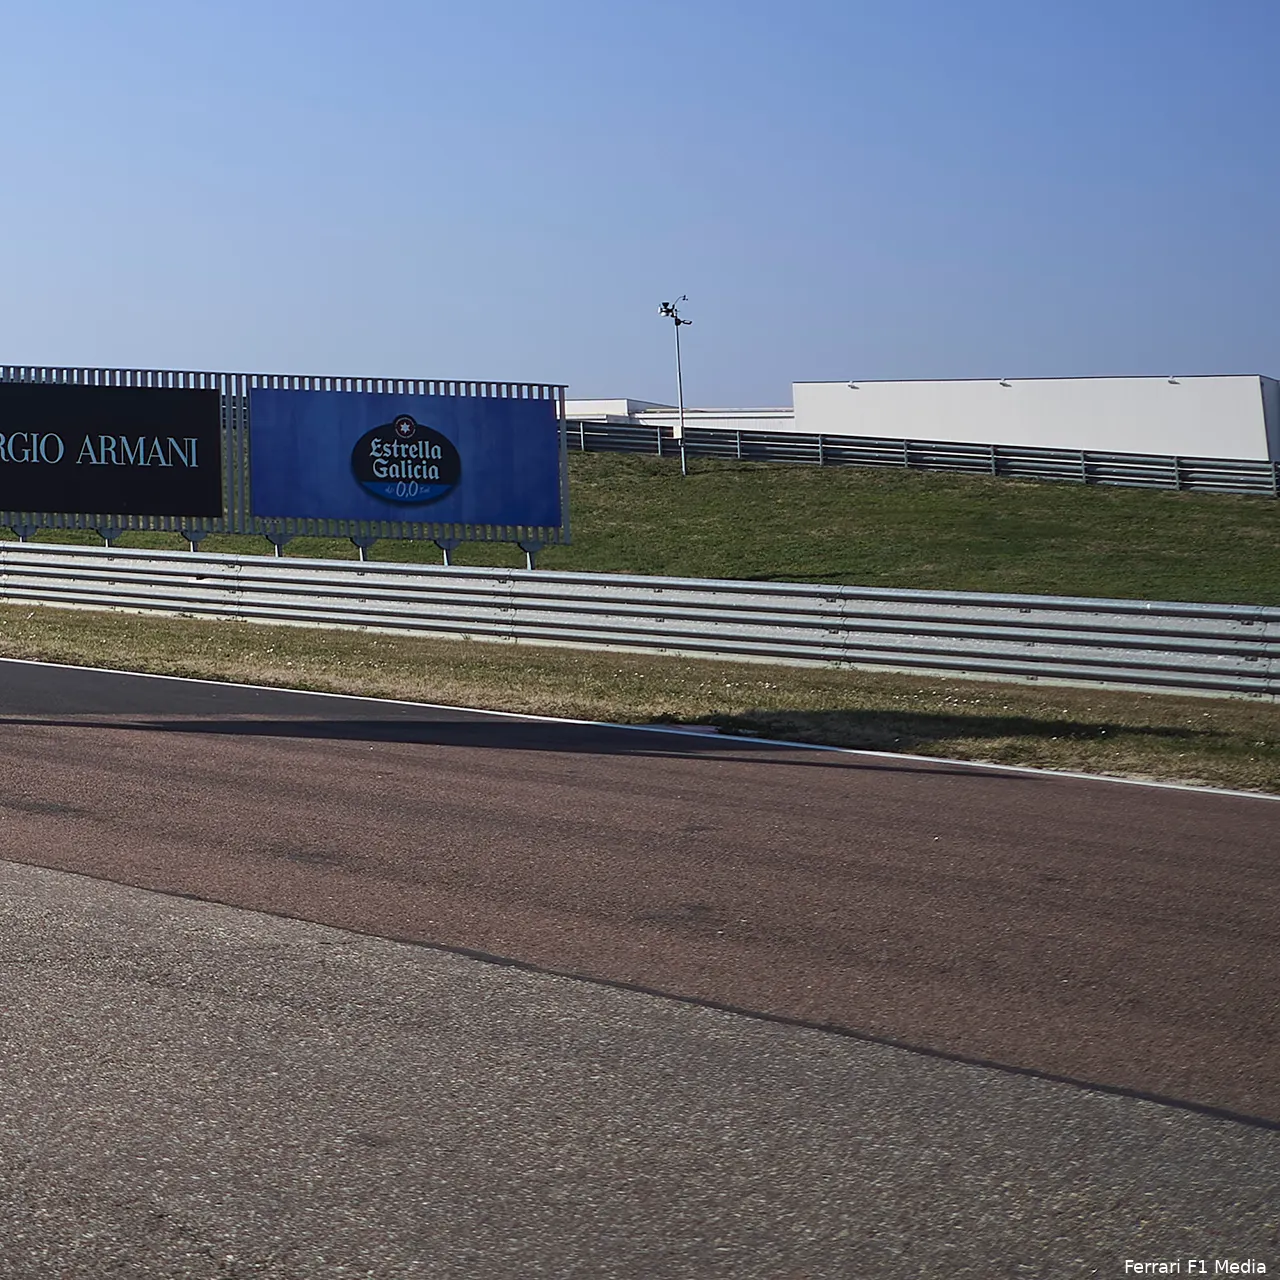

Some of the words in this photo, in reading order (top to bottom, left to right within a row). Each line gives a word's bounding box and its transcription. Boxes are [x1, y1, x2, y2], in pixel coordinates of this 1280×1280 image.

[76, 434, 199, 468] ARMANI
[369, 437, 442, 460] Estrella
[372, 458, 440, 480] Galicia
